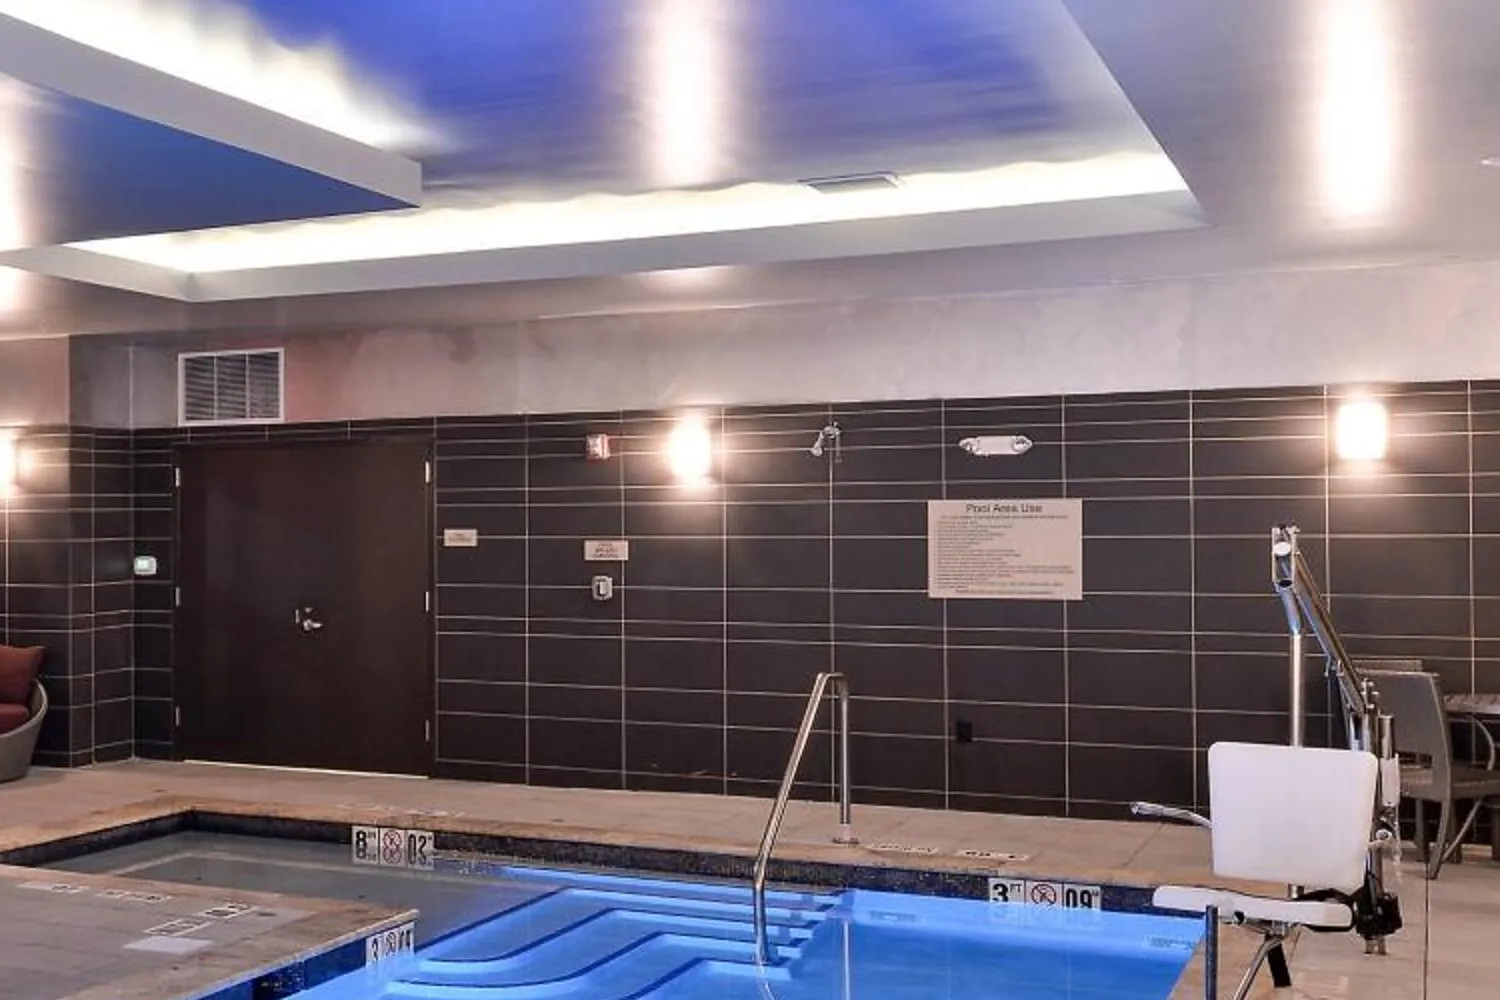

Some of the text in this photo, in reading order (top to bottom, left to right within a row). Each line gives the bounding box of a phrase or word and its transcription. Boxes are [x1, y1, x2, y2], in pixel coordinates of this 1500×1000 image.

[965, 503, 1043, 513] Pool Area Use
[993, 883, 1009, 902] 3
